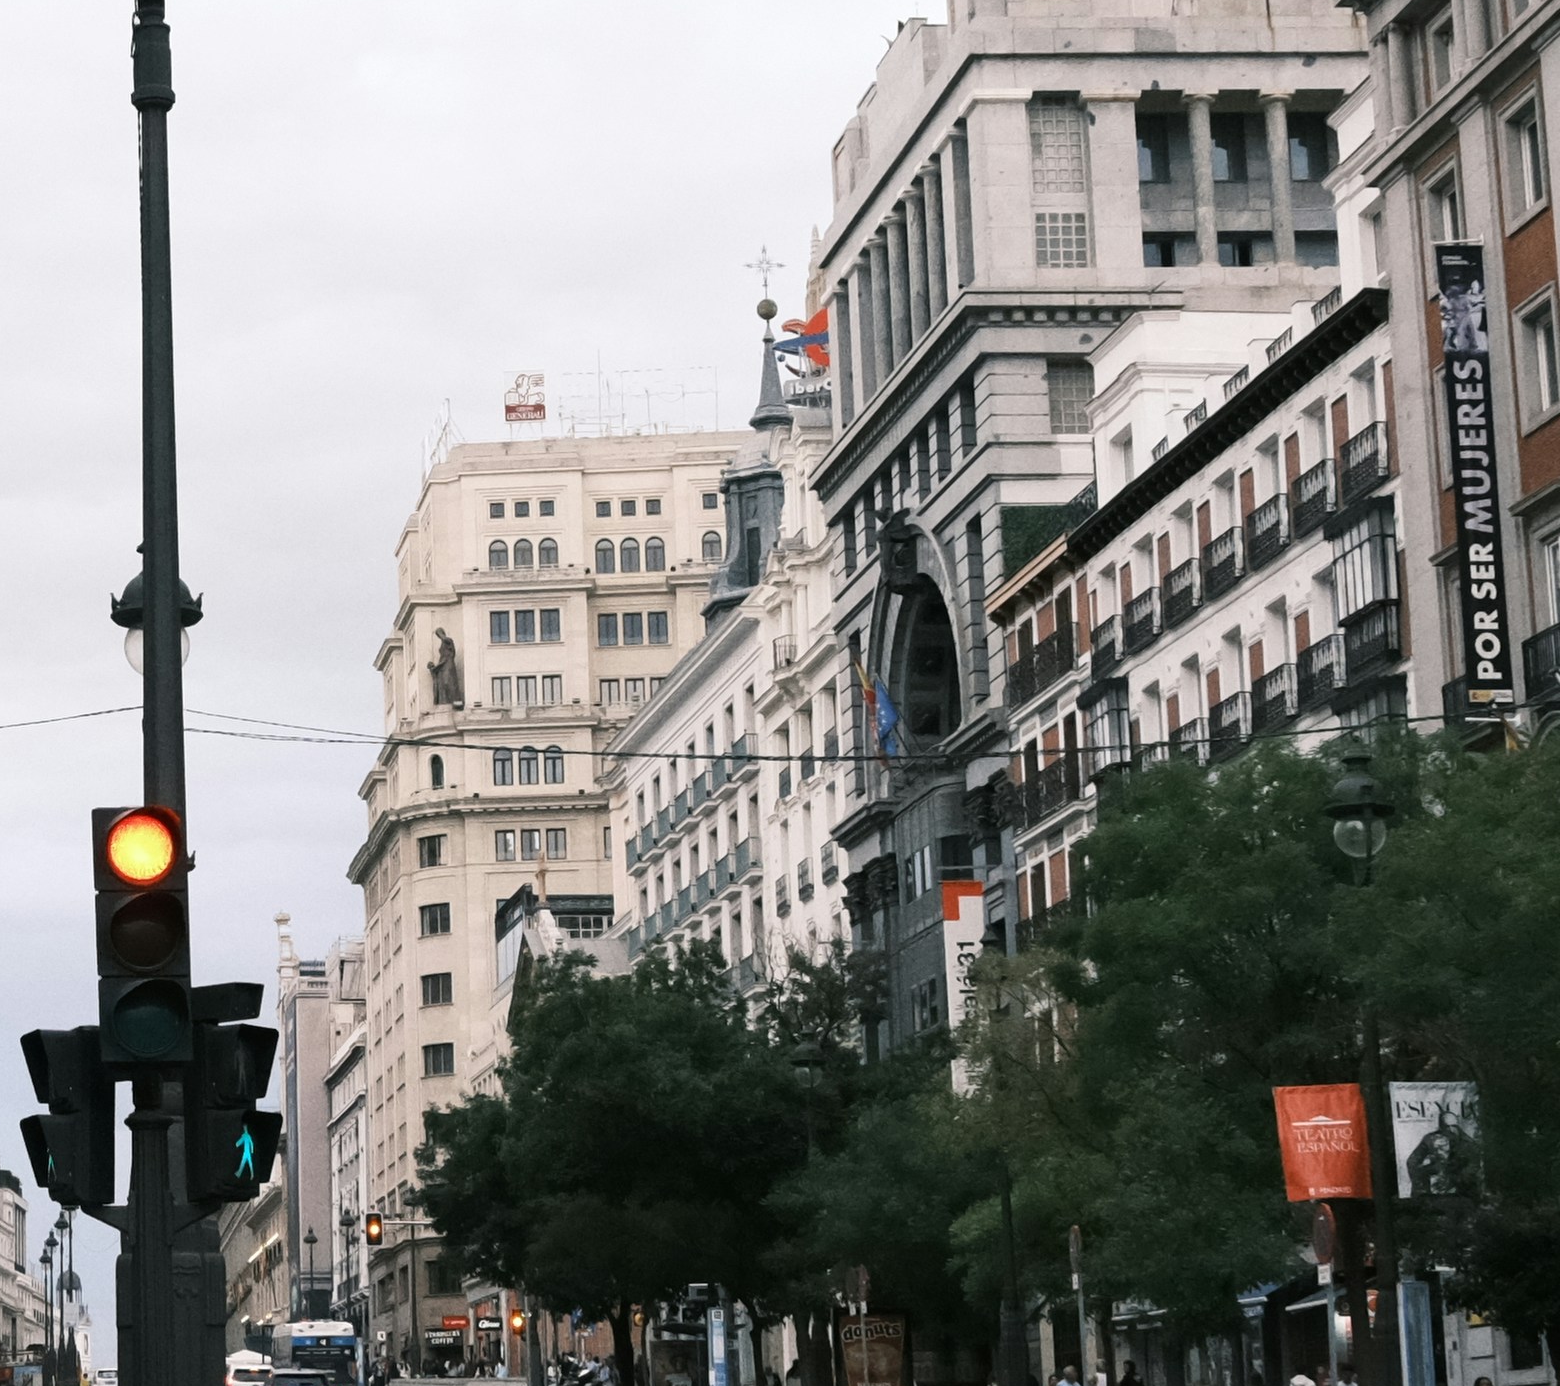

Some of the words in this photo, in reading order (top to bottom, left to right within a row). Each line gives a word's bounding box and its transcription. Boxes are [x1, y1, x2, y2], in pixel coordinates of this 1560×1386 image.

[506, 409, 545, 421] GENERALI
[1452, 358, 1493, 534] MUJERES
[1470, 541, 1497, 600] SER
[1476, 609, 1503, 682] POR
[1292, 1127, 1354, 1142] TEATRO
[1296, 1138, 1360, 1153] ESPAÑOL
[841, 1322, 902, 1342] donuts
